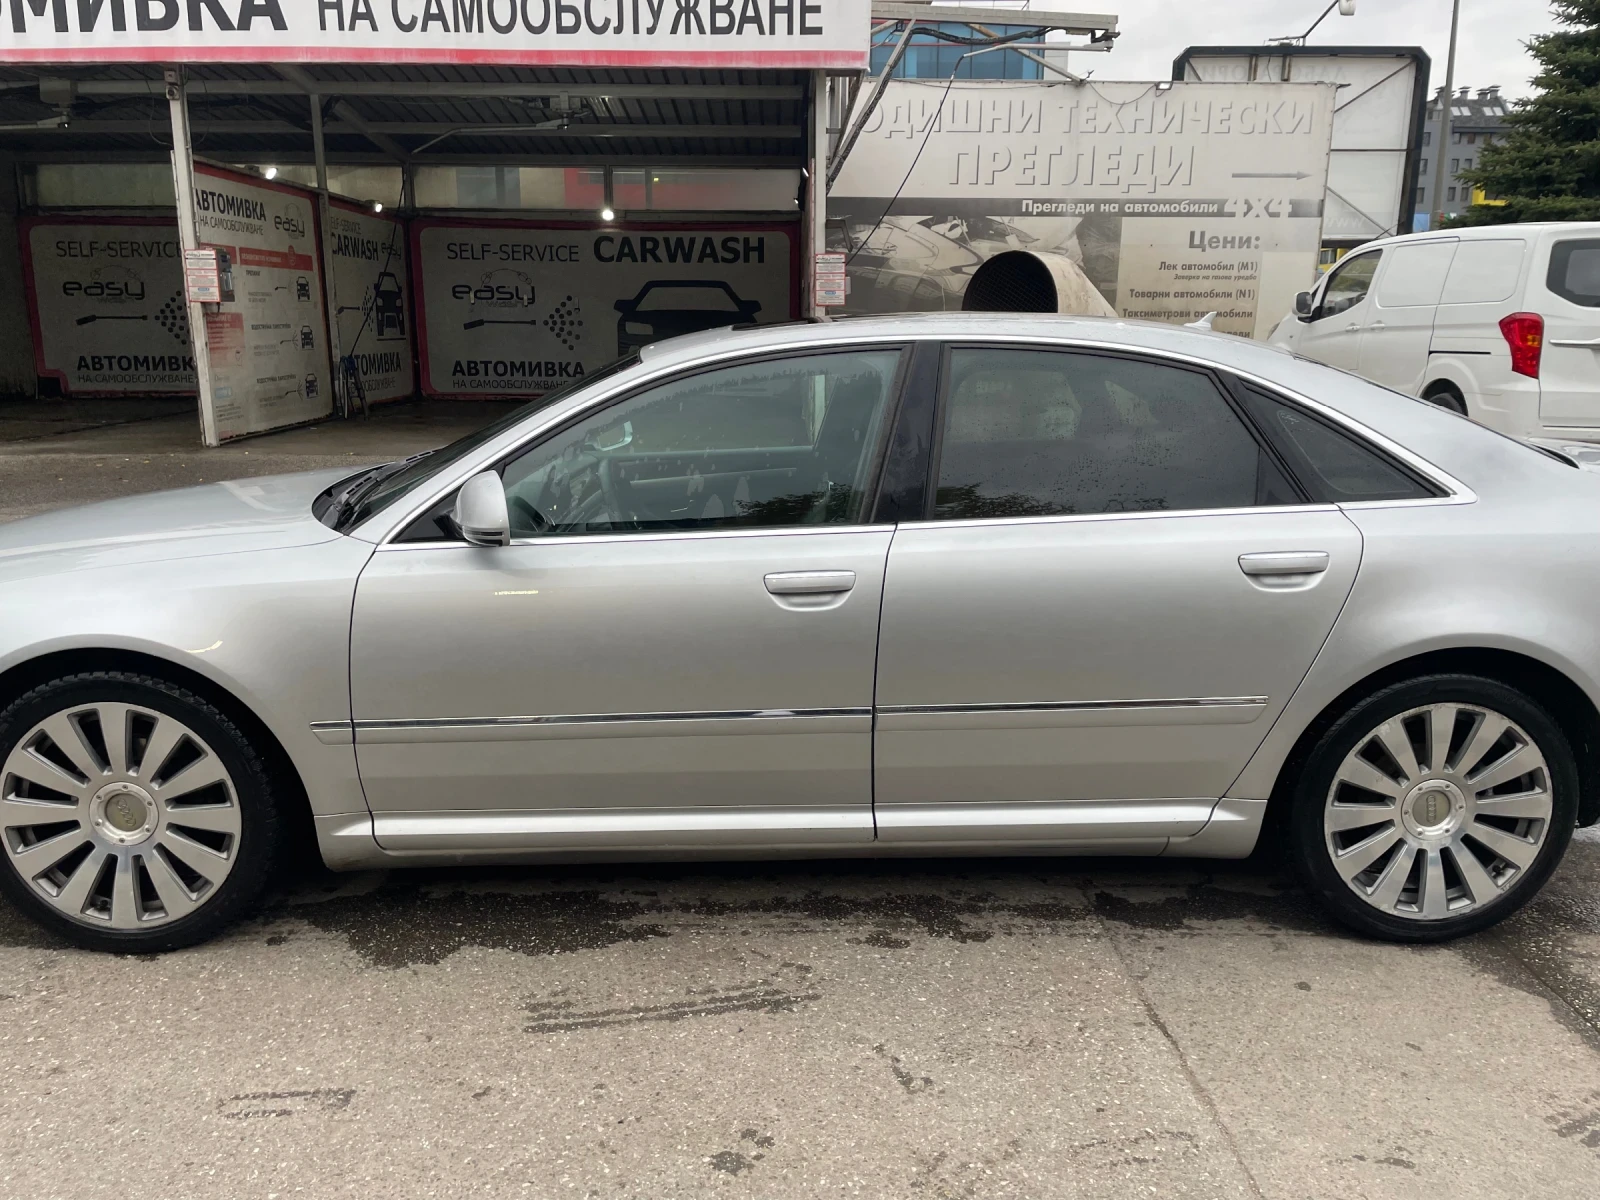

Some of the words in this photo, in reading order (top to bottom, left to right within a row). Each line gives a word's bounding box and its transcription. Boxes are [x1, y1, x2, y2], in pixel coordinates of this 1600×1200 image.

[0, 0, 288, 33] МИВКА
[317, 0, 379, 32] НА
[390, 0, 823, 36] САМООБСЛУЖВАНЕ
[860, 98, 1043, 139] ОДИШНИ
[1057, 98, 1314, 135] ТЕХНИЧЕСКИ
[948, 144, 1195, 194] ПРЕГЛЕДИ
[1021, 199, 1095, 215] Прегледи
[1100, 203, 1120, 213] на
[1124, 200, 1218, 213] автомобили
[274, 215, 305, 238] easy
[447, 242, 580, 262] SELF-SERVICE
[593, 235, 765, 264] CARWASH
[1188, 230, 1261, 253] Цени:
[1159, 261, 1178, 271] Лек
[1181, 261, 1234, 271] автомобил
[1237, 261, 1258, 273] (M1)
[62, 281, 146, 300] easy
[452, 284, 536, 306] easy
[1129, 288, 1170, 300] Товарни
[1173, 289, 1233, 299] автомобили
[1235, 289, 1255, 300] (N1)
[1122, 308, 1191, 320] Таксиметрови
[77, 355, 195, 372] АВТОМИВК
[354, 352, 402, 376] ТОМИВКА
[452, 360, 586, 378] АВТОМИВКА
[78, 374, 92, 383] НА
[95, 373, 194, 384] САМООБСЛУЖВАНЕ
[453, 380, 467, 388] НА
